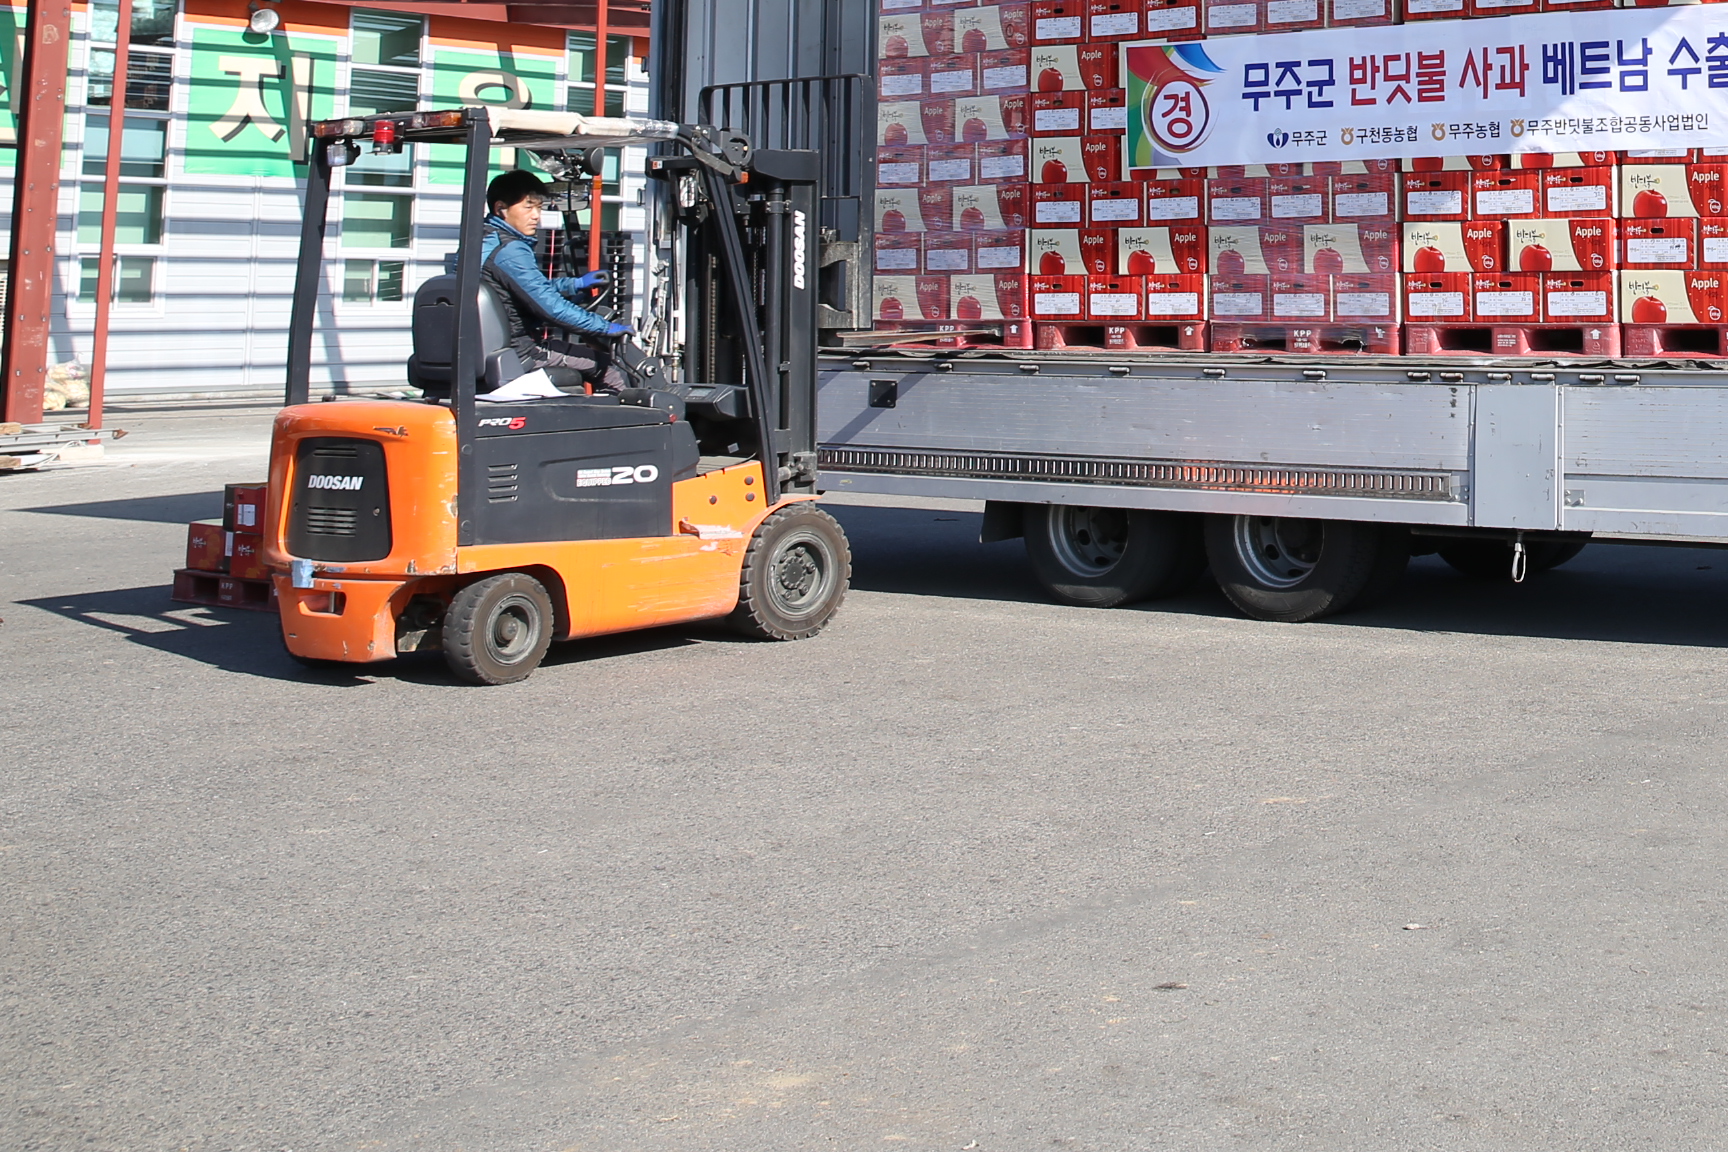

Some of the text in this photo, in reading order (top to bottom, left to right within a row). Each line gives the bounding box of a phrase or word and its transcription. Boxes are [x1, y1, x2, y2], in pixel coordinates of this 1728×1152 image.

[1003, 8, 1023, 19] Apple
[924, 17, 943, 27] Apple
[1081, 49, 1102, 60] Apple
[1241, 58, 1335, 111] 무주군
[1349, 49, 1447, 106] 반딧불
[1458, 45, 1529, 99] 사과
[1542, 37, 1652, 96] 베트남
[1003, 98, 1024, 109] Apple
[924, 106, 943, 115] Apple
[1162, 92, 1193, 138] 경
[1526, 113, 1709, 136] 무주반딧불조합공동사업법인
[1356, 126, 1418, 145] 구천동농협
[1448, 121, 1500, 140] 무주농협
[1291, 130, 1327, 147] 무주군
[1085, 142, 1106, 153] Apple
[1691, 171, 1720, 183] Apple
[922, 193, 942, 203] Apple
[1001, 189, 1021, 200] Apple
[1363, 229, 1388, 241] Apple
[1467, 228, 1492, 240] Apple
[1575, 226, 1602, 237] Apple
[1083, 234, 1104, 245] Apple
[1174, 232, 1197, 243] Apple
[1263, 232, 1287, 243] Apple
[793, 209, 806, 290] DOOSAN
[919, 281, 939, 292] Apple
[998, 279, 1019, 291] Apple
[1691, 277, 1719, 290] Apple
[1108, 326, 1126, 334] KPP
[1293, 329, 1312, 338] KPP
[478, 416, 527, 430] PRO5
[307, 474, 364, 491] DOOSAN
